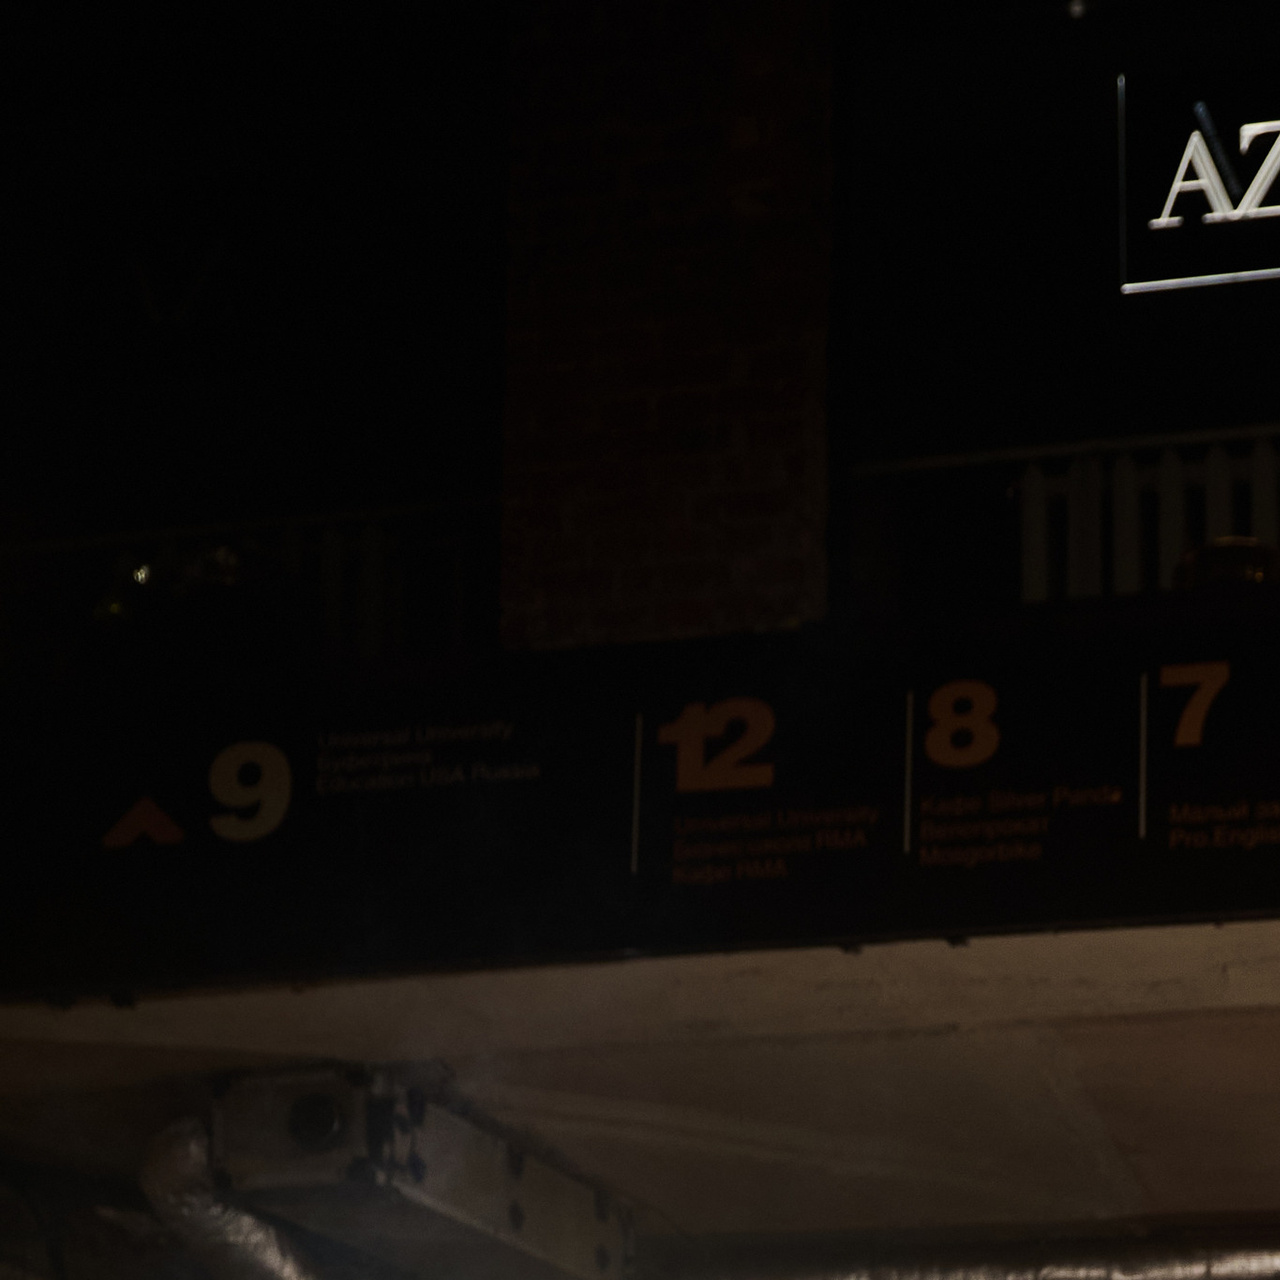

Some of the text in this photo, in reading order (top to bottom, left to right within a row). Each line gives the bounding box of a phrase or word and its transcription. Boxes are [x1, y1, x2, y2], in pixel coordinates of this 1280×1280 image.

[656, 695, 777, 795] 12
[923, 677, 1001, 769] 8
[1158, 659, 1232, 749] 7
[207, 739, 294, 844] 9
